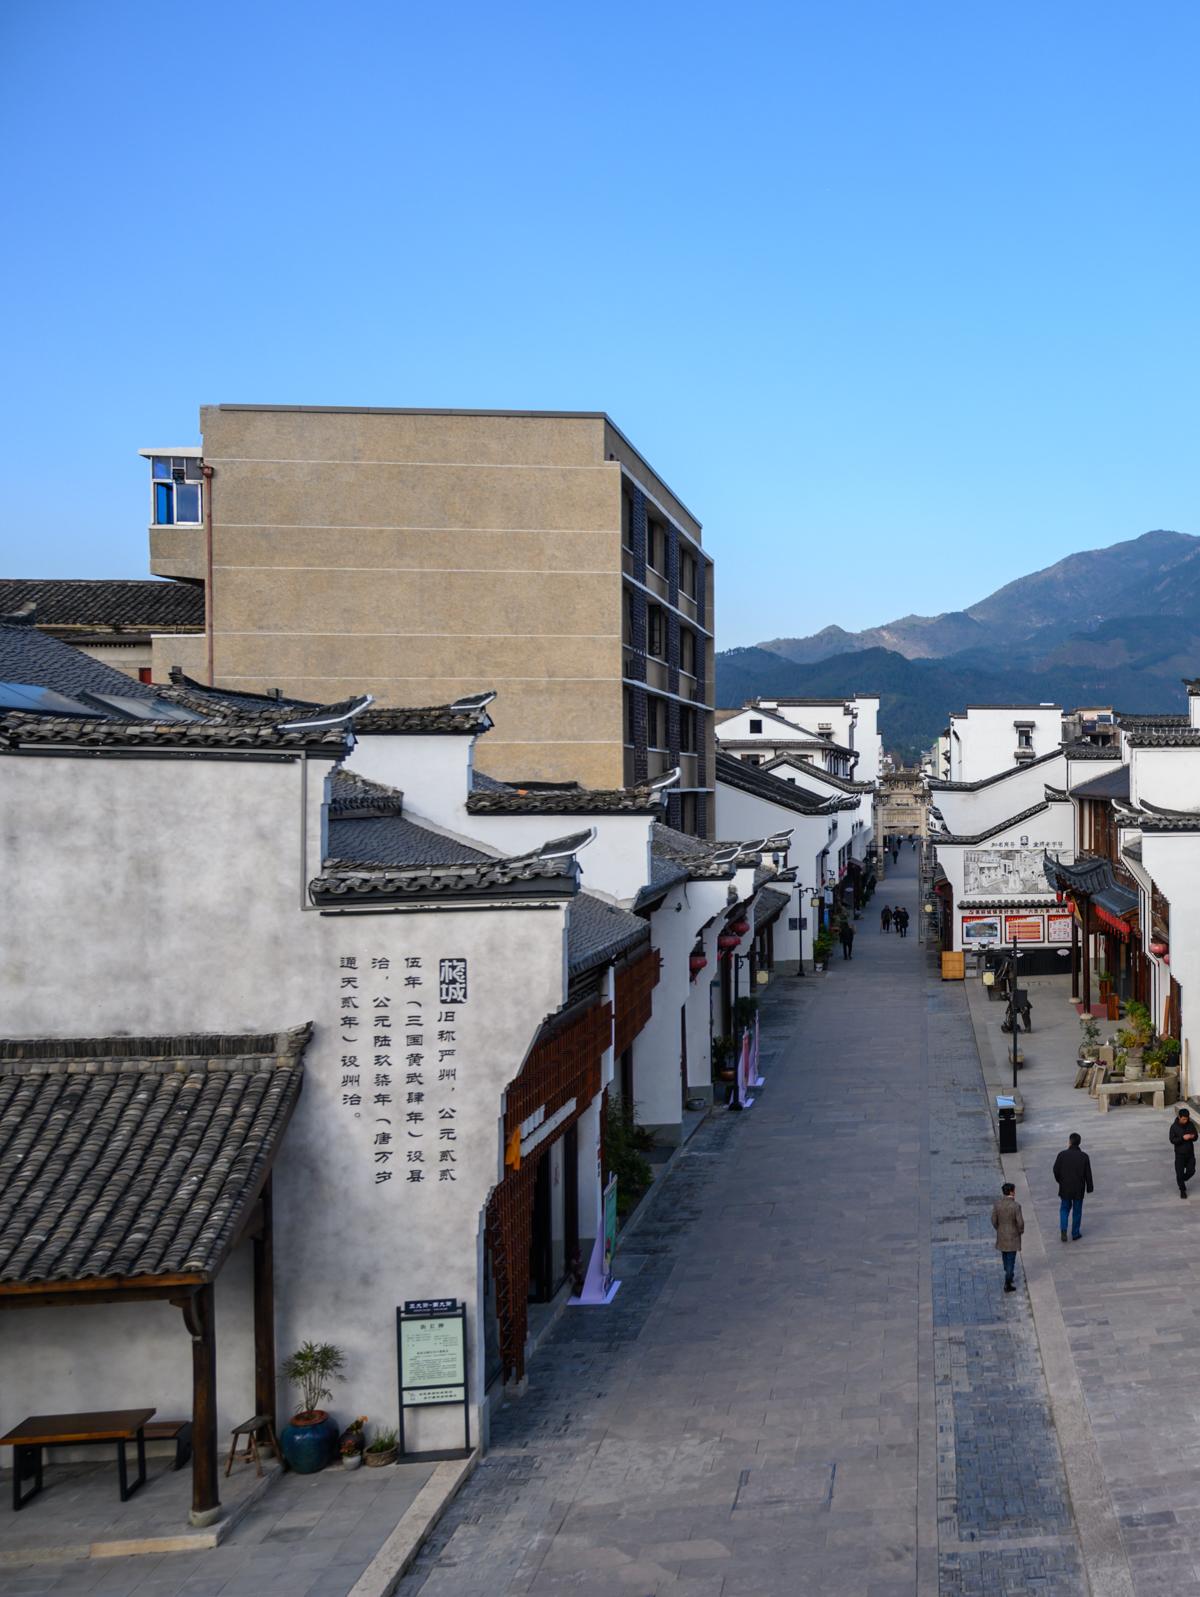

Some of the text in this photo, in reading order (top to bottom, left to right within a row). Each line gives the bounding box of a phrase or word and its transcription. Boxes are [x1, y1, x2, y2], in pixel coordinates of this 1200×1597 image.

[340, 957, 361, 1118] 通天贰年）设州治。
[371, 957, 393, 1184] 治，公元陆玖柒年（唐万岁
[404, 957, 425, 1183] 伍年（三国黄武肆年）设县
[438, 1011, 457, 1182] 旧称严州，公元贰贰
